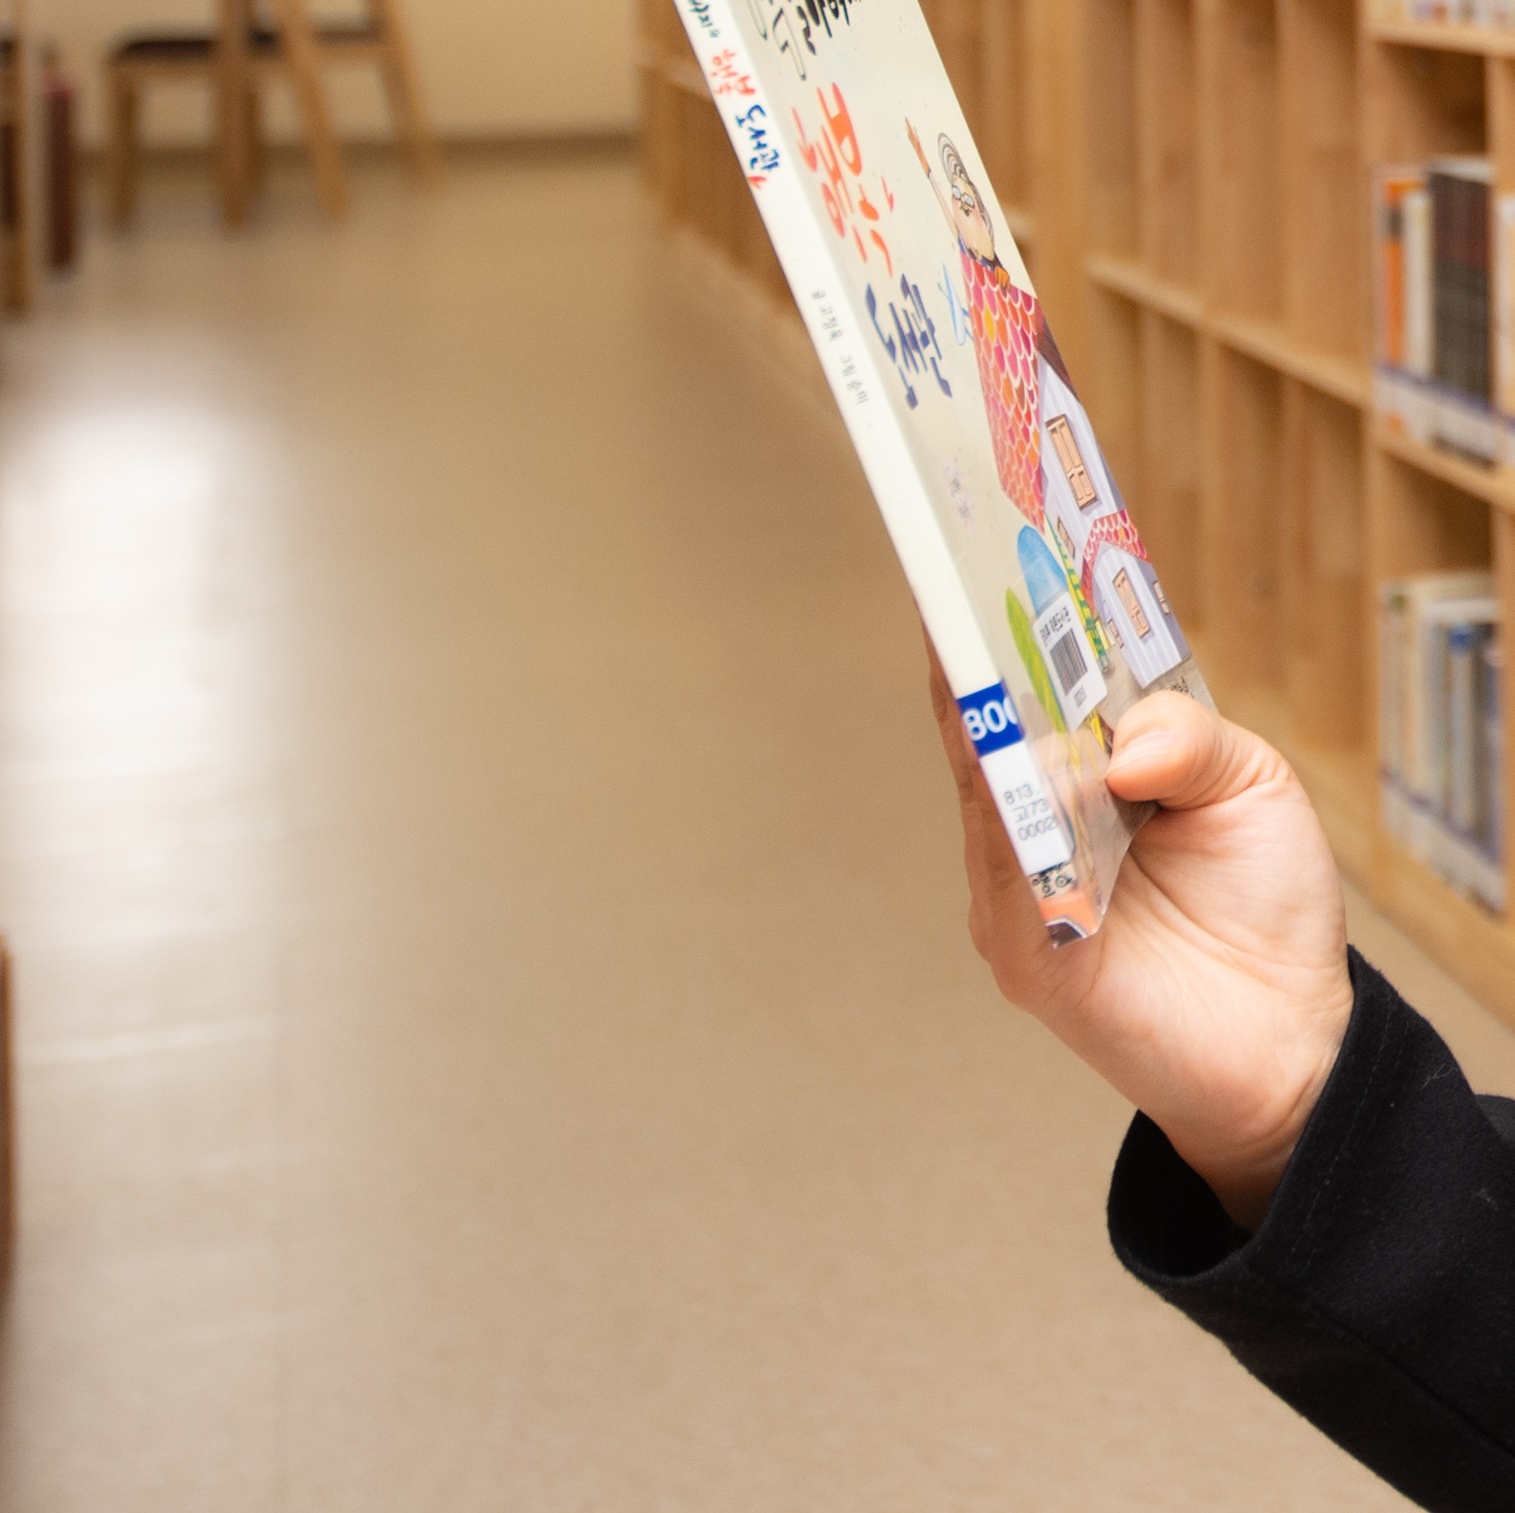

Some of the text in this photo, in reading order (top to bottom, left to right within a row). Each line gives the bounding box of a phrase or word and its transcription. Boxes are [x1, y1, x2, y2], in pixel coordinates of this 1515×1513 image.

[711, 49, 756, 96] 행복
[735, 104, 780, 172] 도서관
[791, 82, 893, 279] 행복
[865, 272, 952, 411] 도서관
